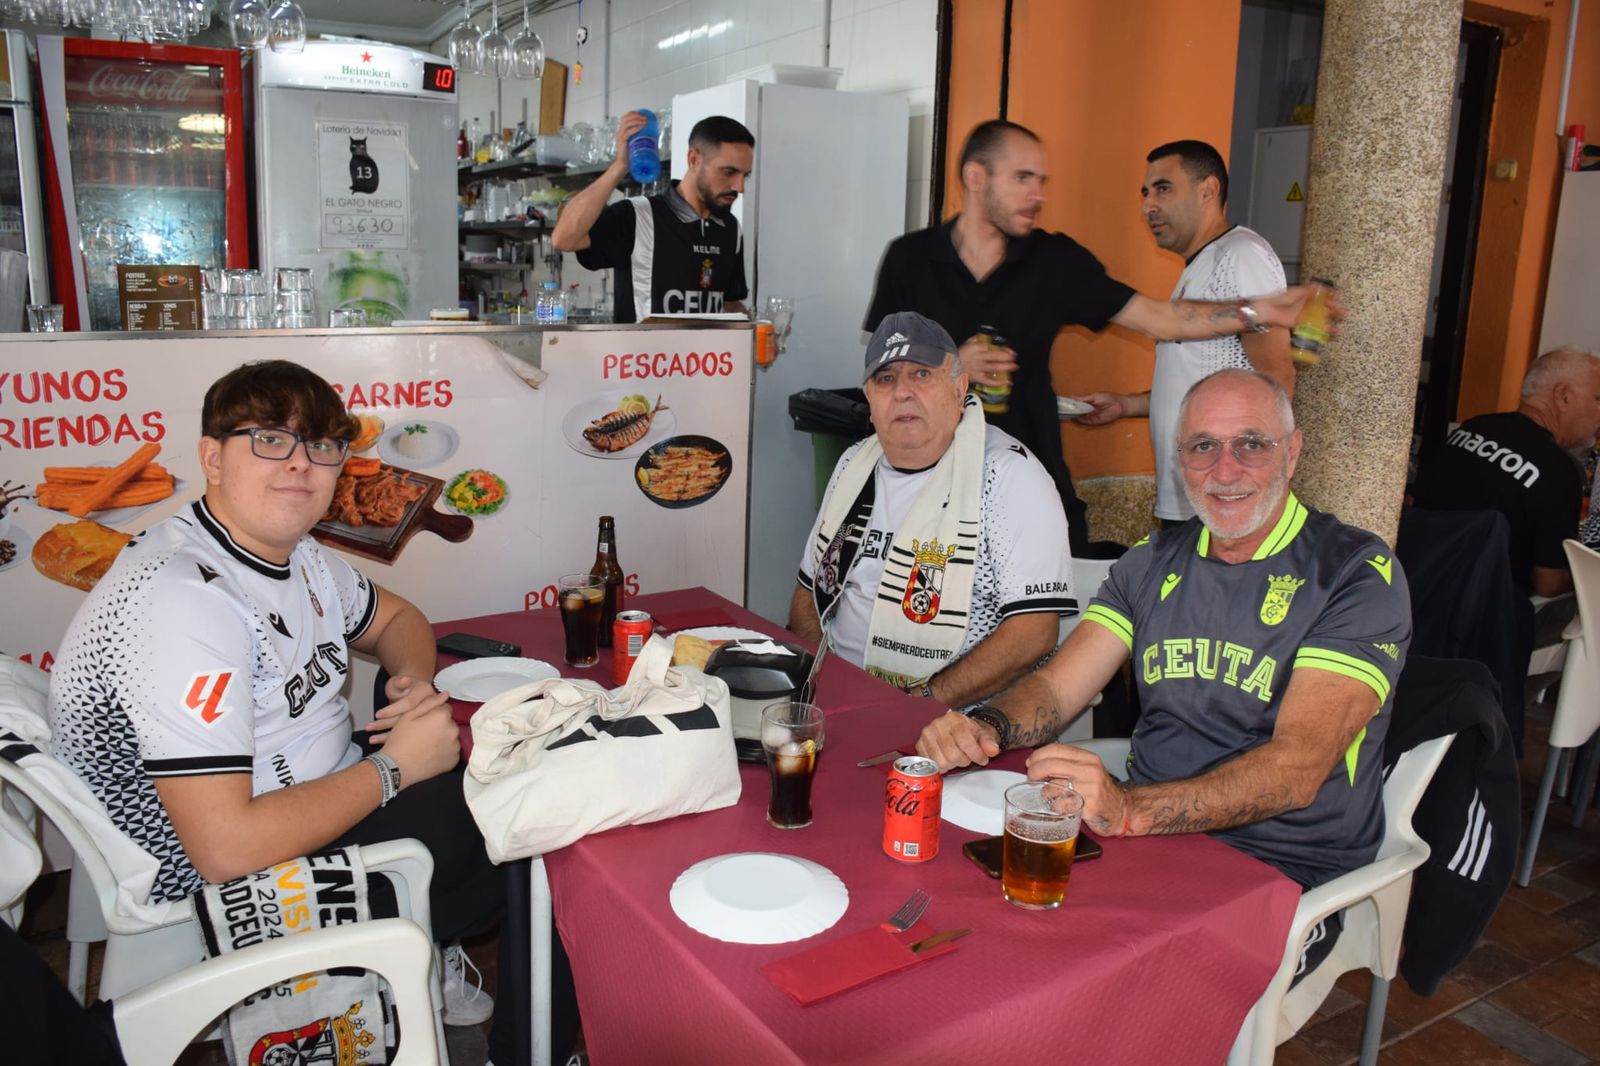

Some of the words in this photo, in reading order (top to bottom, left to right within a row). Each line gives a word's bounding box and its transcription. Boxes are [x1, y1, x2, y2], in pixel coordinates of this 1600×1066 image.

[341, 64, 391, 78] Heineken
[350, 78, 381, 87] EXTRA
[384, 80, 409, 89] COLD
[353, 126, 364, 134] de
[367, 127, 402, 136] Navidad
[356, 166, 372, 179] 13
[325, 198, 335, 207] EL
[338, 198, 365, 208] GATO
[368, 199, 402, 208] NEGRO
[693, 245, 720, 254] KELME
[603, 352, 733, 379] PESCADOS
[330, 379, 453, 410] ARNES
[1446, 429, 1540, 488] macron
[1143, 638, 1277, 702] CEUTA
[886, 778, 921, 816] ola
